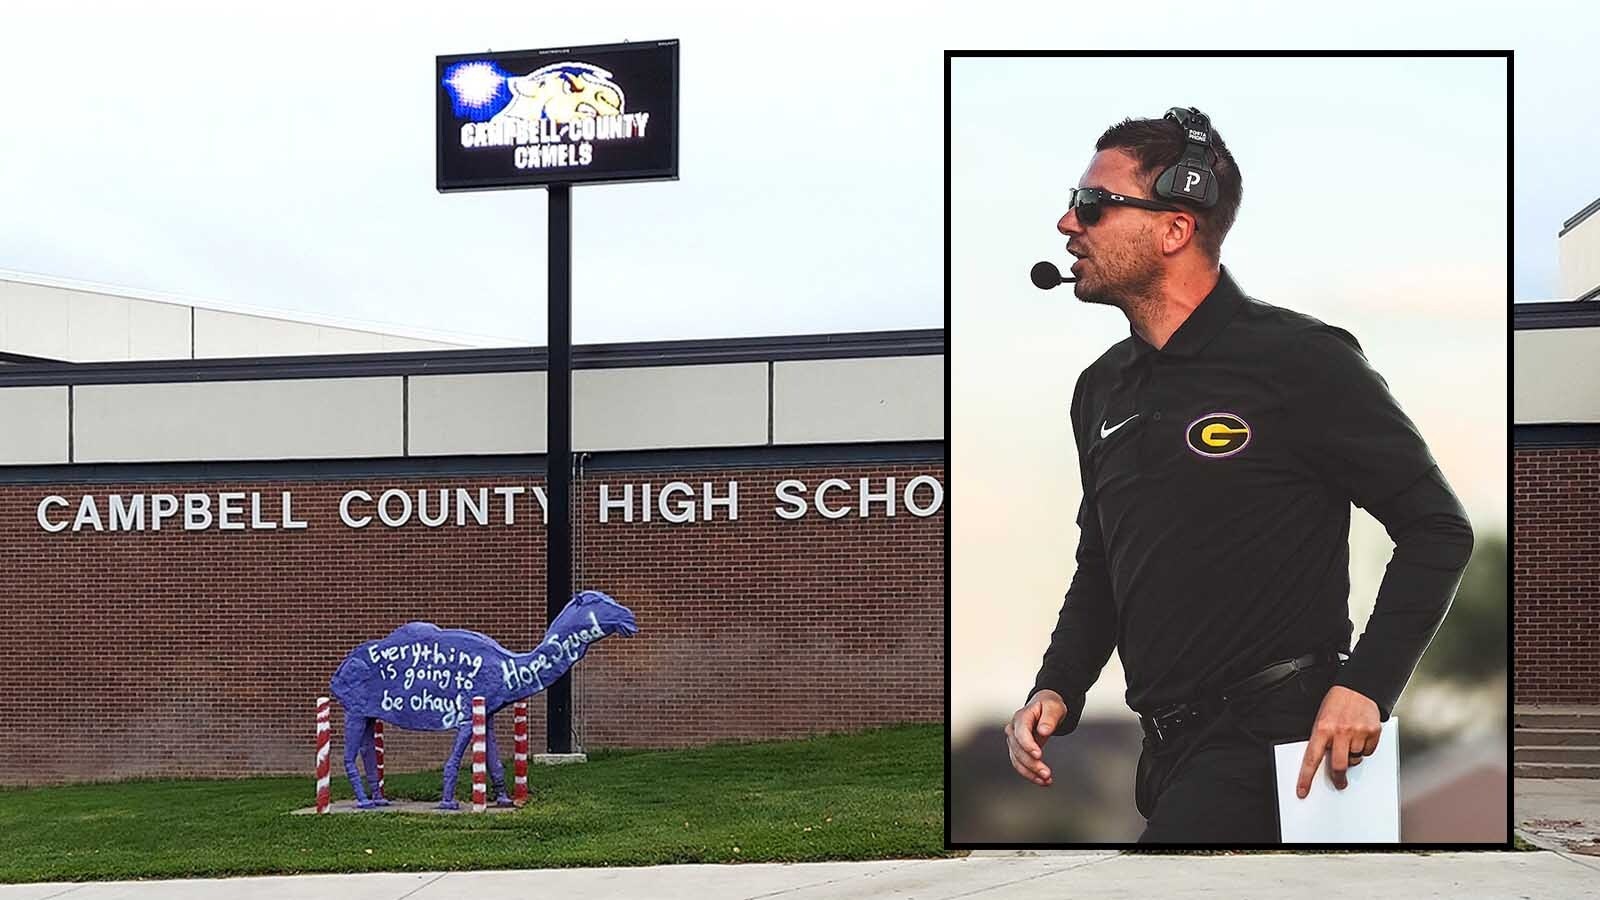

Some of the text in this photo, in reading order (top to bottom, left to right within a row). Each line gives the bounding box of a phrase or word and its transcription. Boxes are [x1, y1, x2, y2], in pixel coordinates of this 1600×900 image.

[460, 112, 649, 147] CAMPBELL COUNTY
[514, 142, 593, 168] CAMELS
[1183, 171, 1201, 193] P
[36, 491, 308, 532] CAMPBELL
[599, 480, 739, 524] HIGH
[774, 475, 944, 520] SCHO
[368, 642, 483, 679] Everything
[501, 611, 606, 690] Hope Squad
[380, 663, 474, 690] is going to
[381, 689, 404, 711] be
